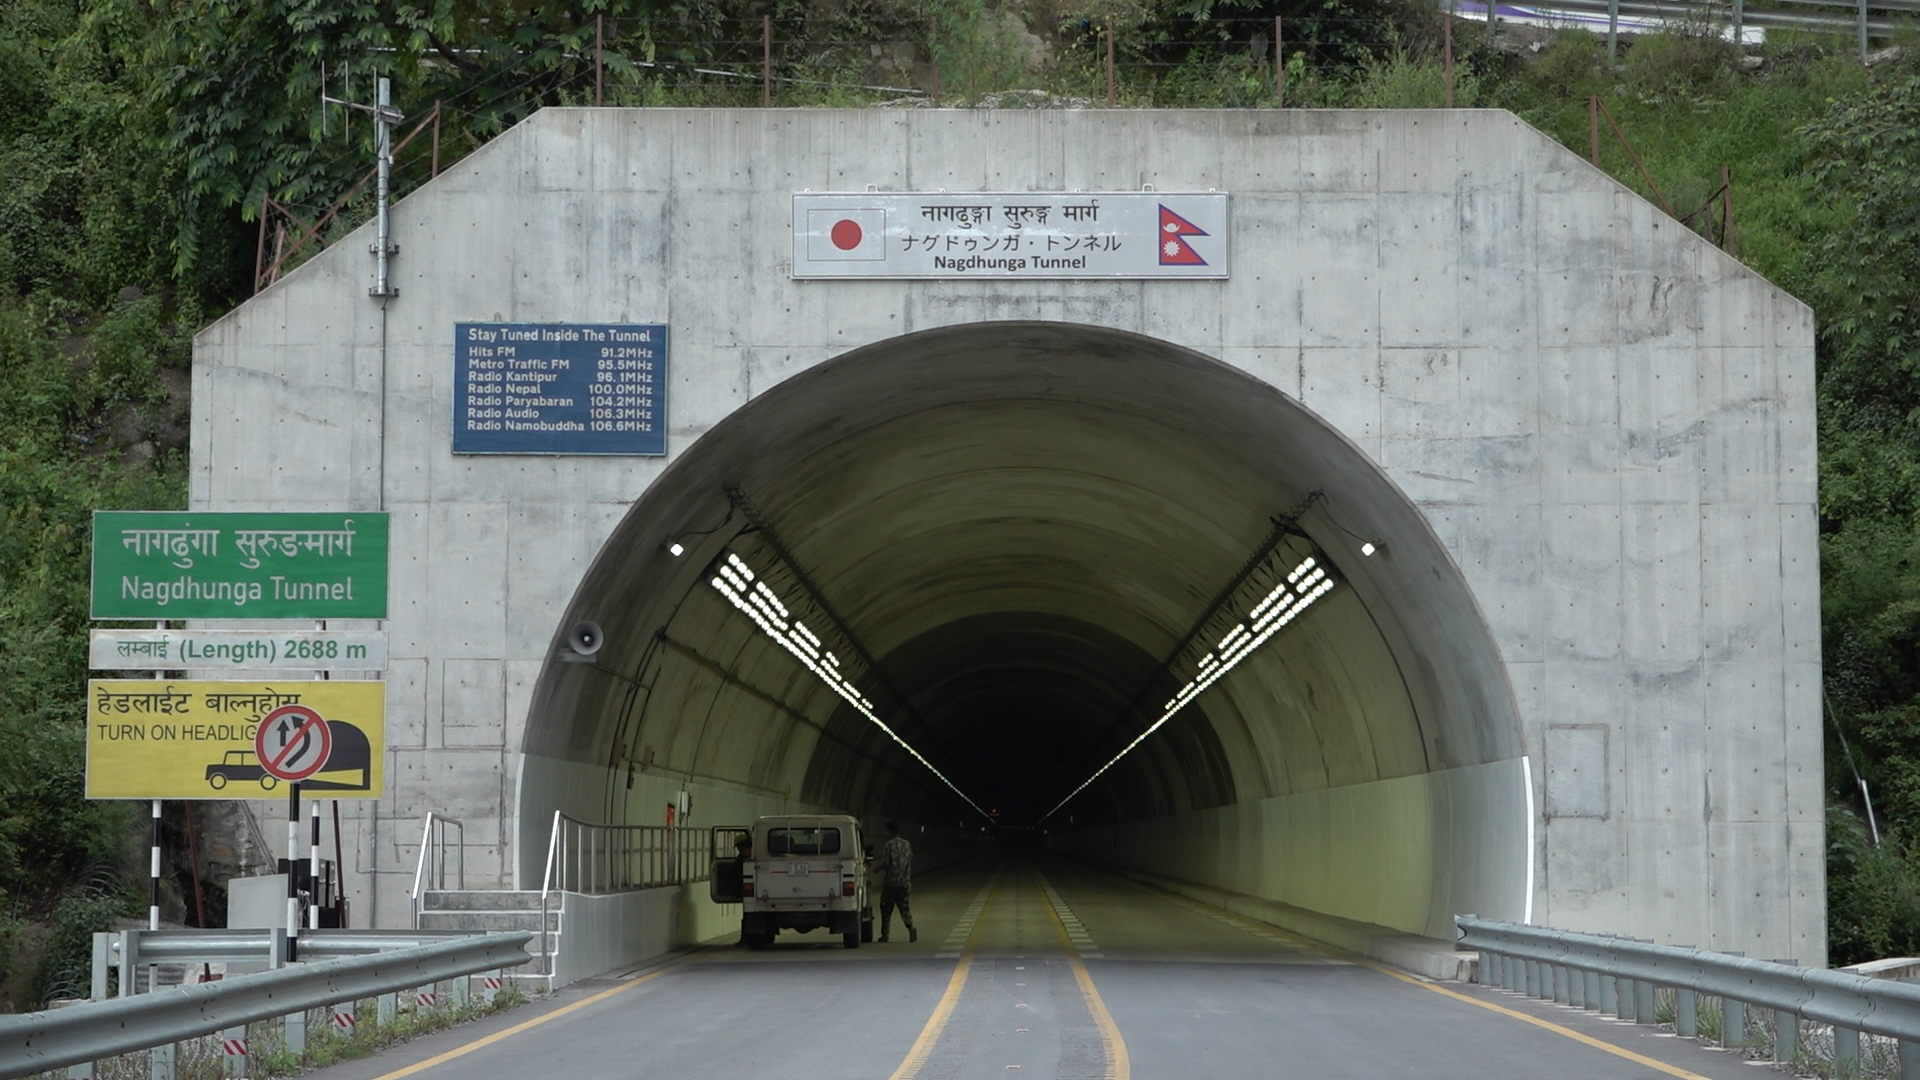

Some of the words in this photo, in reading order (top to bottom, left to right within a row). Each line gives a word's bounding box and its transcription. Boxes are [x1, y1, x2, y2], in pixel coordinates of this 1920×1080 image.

[1062, 199, 1099, 221] मार्ग
[902, 235, 1122, 251] ナグドゥンガ・トンネル
[935, 255, 1026, 272] Nagdhunga
[1031, 255, 1086, 269] Tunnel
[469, 328, 498, 343] Stay
[501, 329, 539, 341] Tuned
[543, 329, 580, 342] Inside
[583, 329, 606, 342] The
[609, 330, 651, 343] Tunnel
[469, 347, 494, 357] Hits
[498, 347, 516, 357] FM
[601, 348, 653, 359] 91.2MHz
[469, 359, 505, 370] Metro
[508, 359, 548, 370] Traffic
[552, 359, 570, 370] FM
[598, 360, 653, 371] 95.5MHz
[469, 371, 503, 382] Radio
[506, 371, 558, 383] Kantipur
[468, 384, 502, 394] Radio
[506, 384, 542, 396] Nepal
[589, 384, 653, 395] 100.0MHz
[468, 396, 502, 406] Radio
[506, 396, 574, 408] Paryabaran
[591, 396, 652, 407] 104.2MHz
[468, 408, 502, 419] Radio
[505, 408, 540, 419] Audio
[590, 409, 652, 420] 106.3MHz
[468, 420, 502, 431] Radio
[506, 420, 585, 432] Namobuddha
[591, 421, 652, 432] 106.6MHz
[122, 523, 220, 568] नागढुंगा
[123, 576, 262, 607] Nagdhunga
[270, 576, 354, 601] Tunnel
[117, 634, 171, 661] लम्बाई
[179, 639, 277, 664] (Length)
[284, 639, 338, 659] 2688
[346, 644, 367, 660] m
[97, 686, 192, 715] हेडलाईट
[97, 725, 146, 741] TURN
[151, 725, 177, 741] ON
[183, 724, 256, 742] HEADLIG
